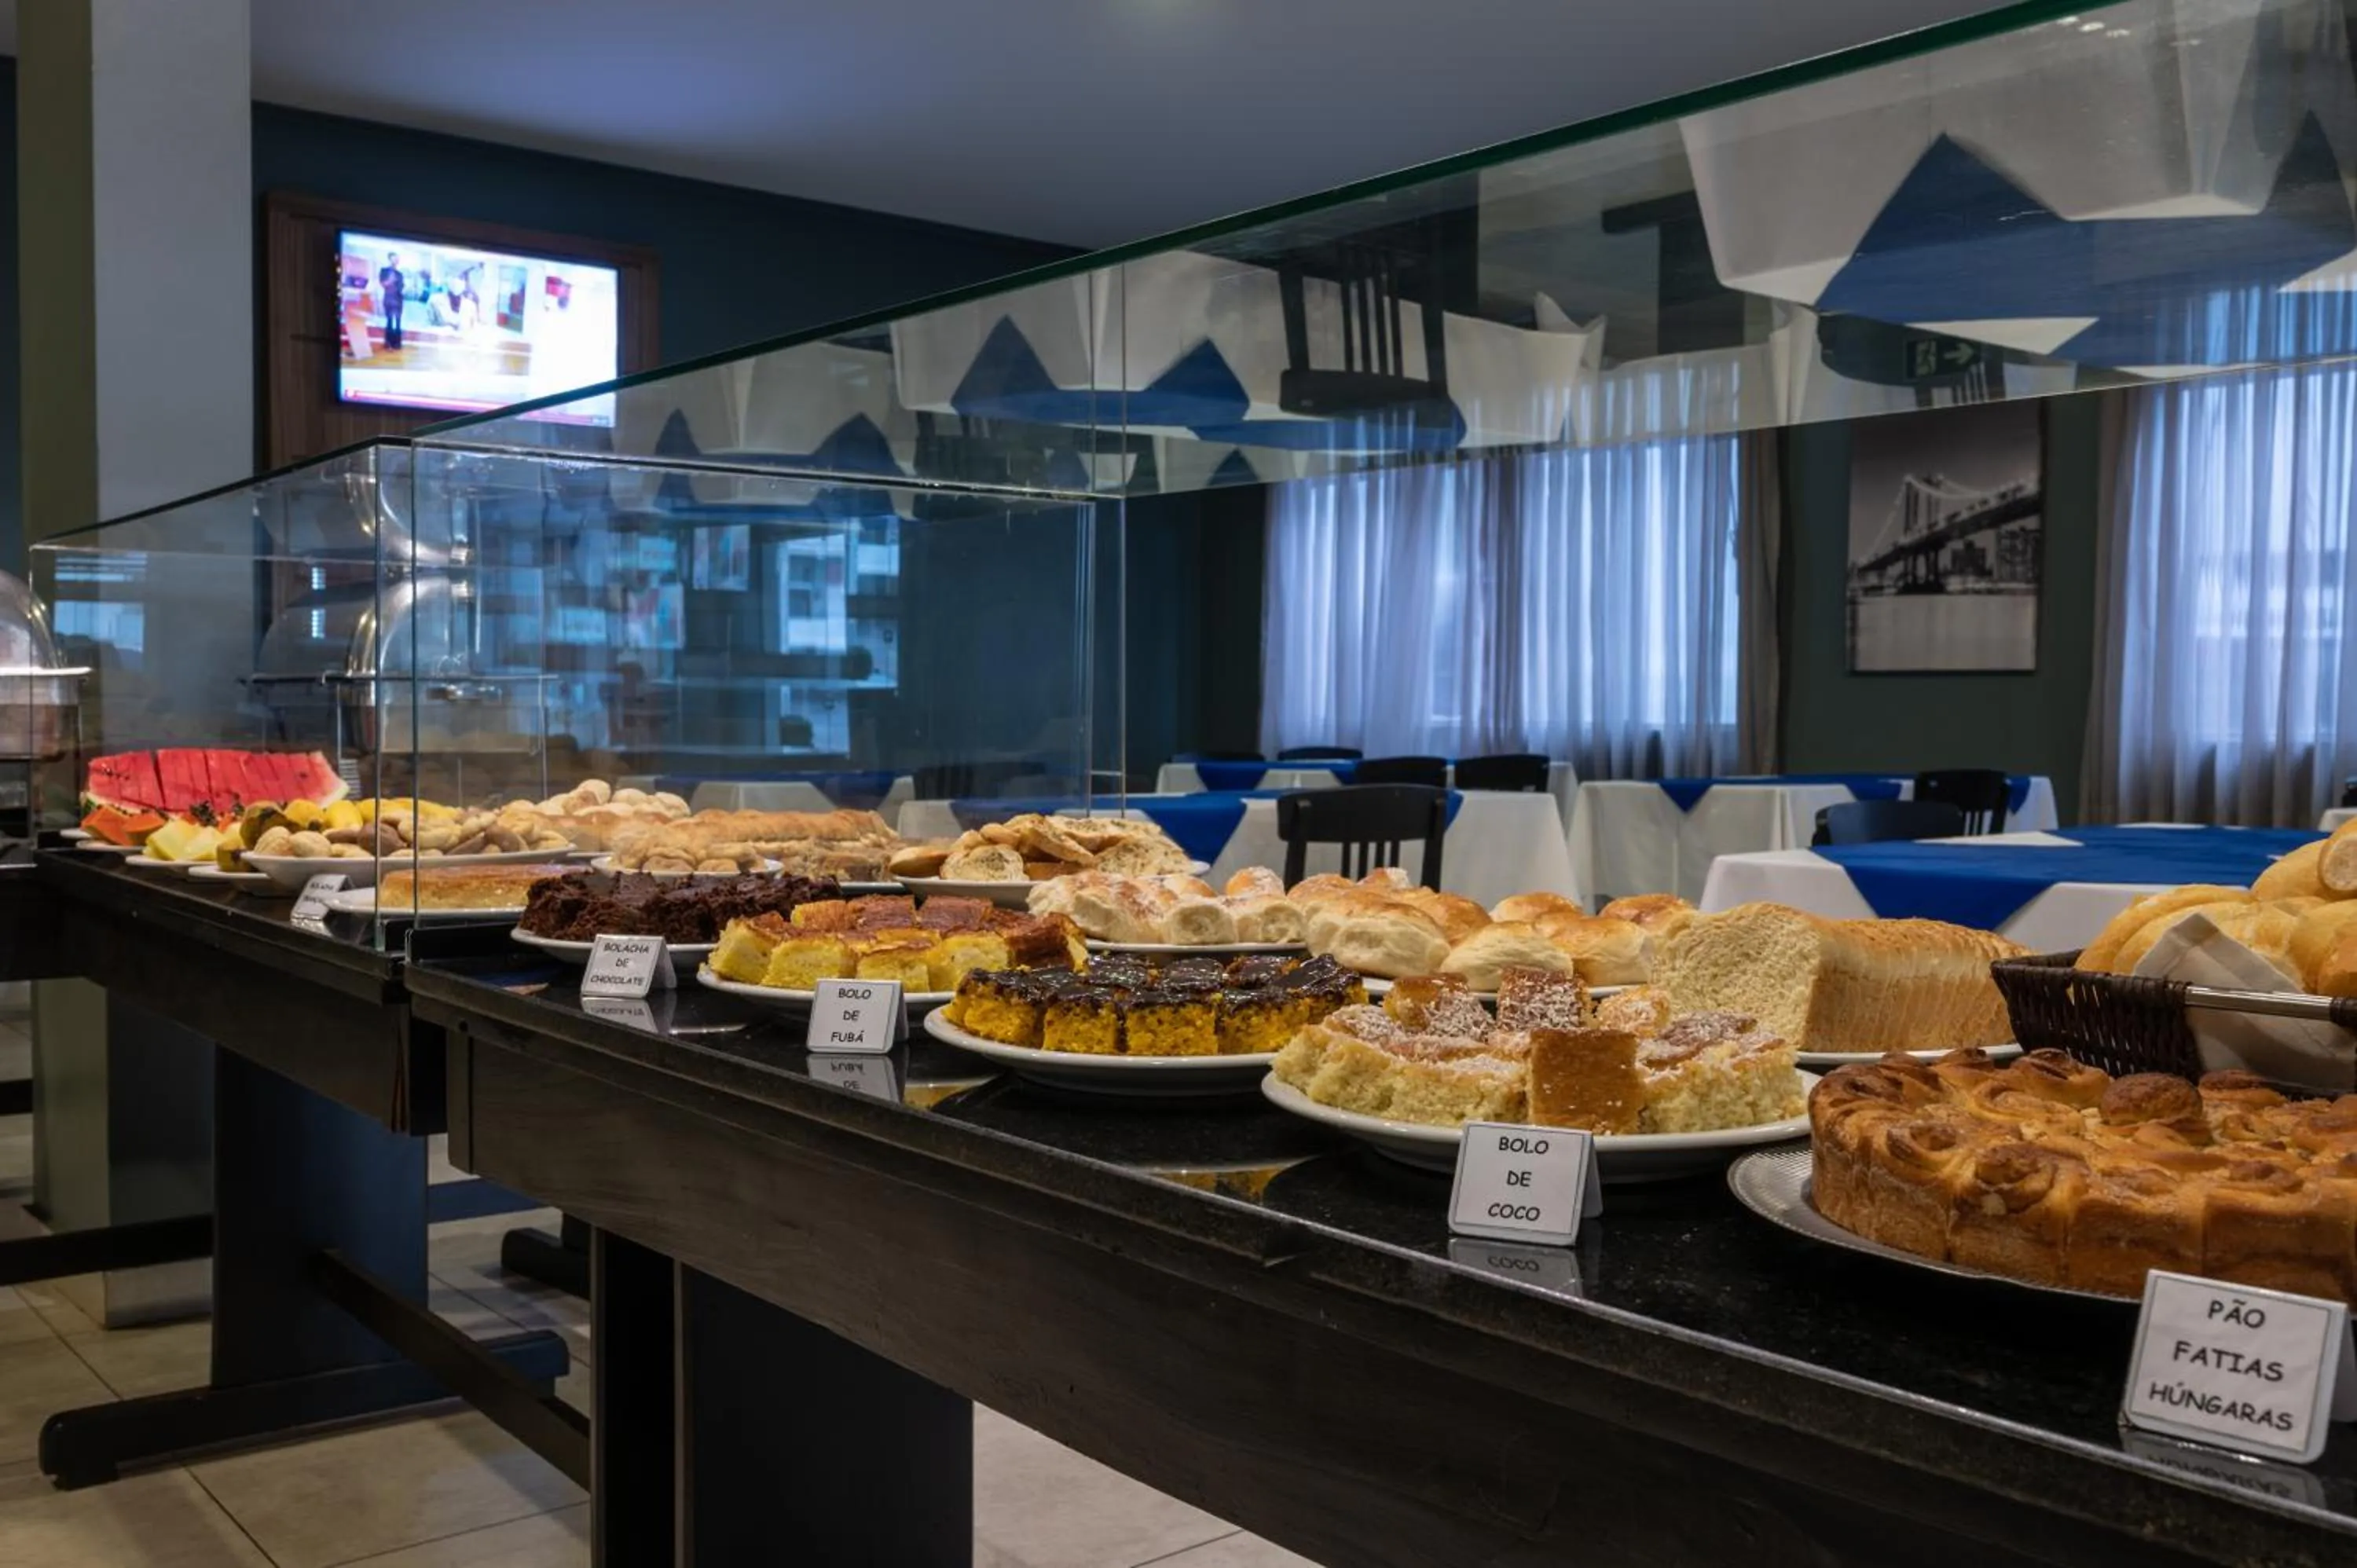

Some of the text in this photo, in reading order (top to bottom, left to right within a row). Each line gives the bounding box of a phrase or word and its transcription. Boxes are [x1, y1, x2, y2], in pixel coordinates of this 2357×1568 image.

[603, 943, 650, 954] BOLACHA
[615, 958, 629, 967] DE
[590, 975, 644, 986] CHOCOLATE
[838, 987, 871, 999] BOLO
[843, 1010, 860, 1020] DE
[830, 1030, 864, 1043] FUBÁ
[1498, 1137, 1549, 1154] BOLO
[1506, 1171, 1532, 1187] DE
[1487, 1203, 1541, 1222] COCO
[2207, 1299, 2266, 1328] PÃO
[2172, 1340, 2284, 1382] FATIAS
[2148, 1382, 2293, 1432] HÚNGARAS
